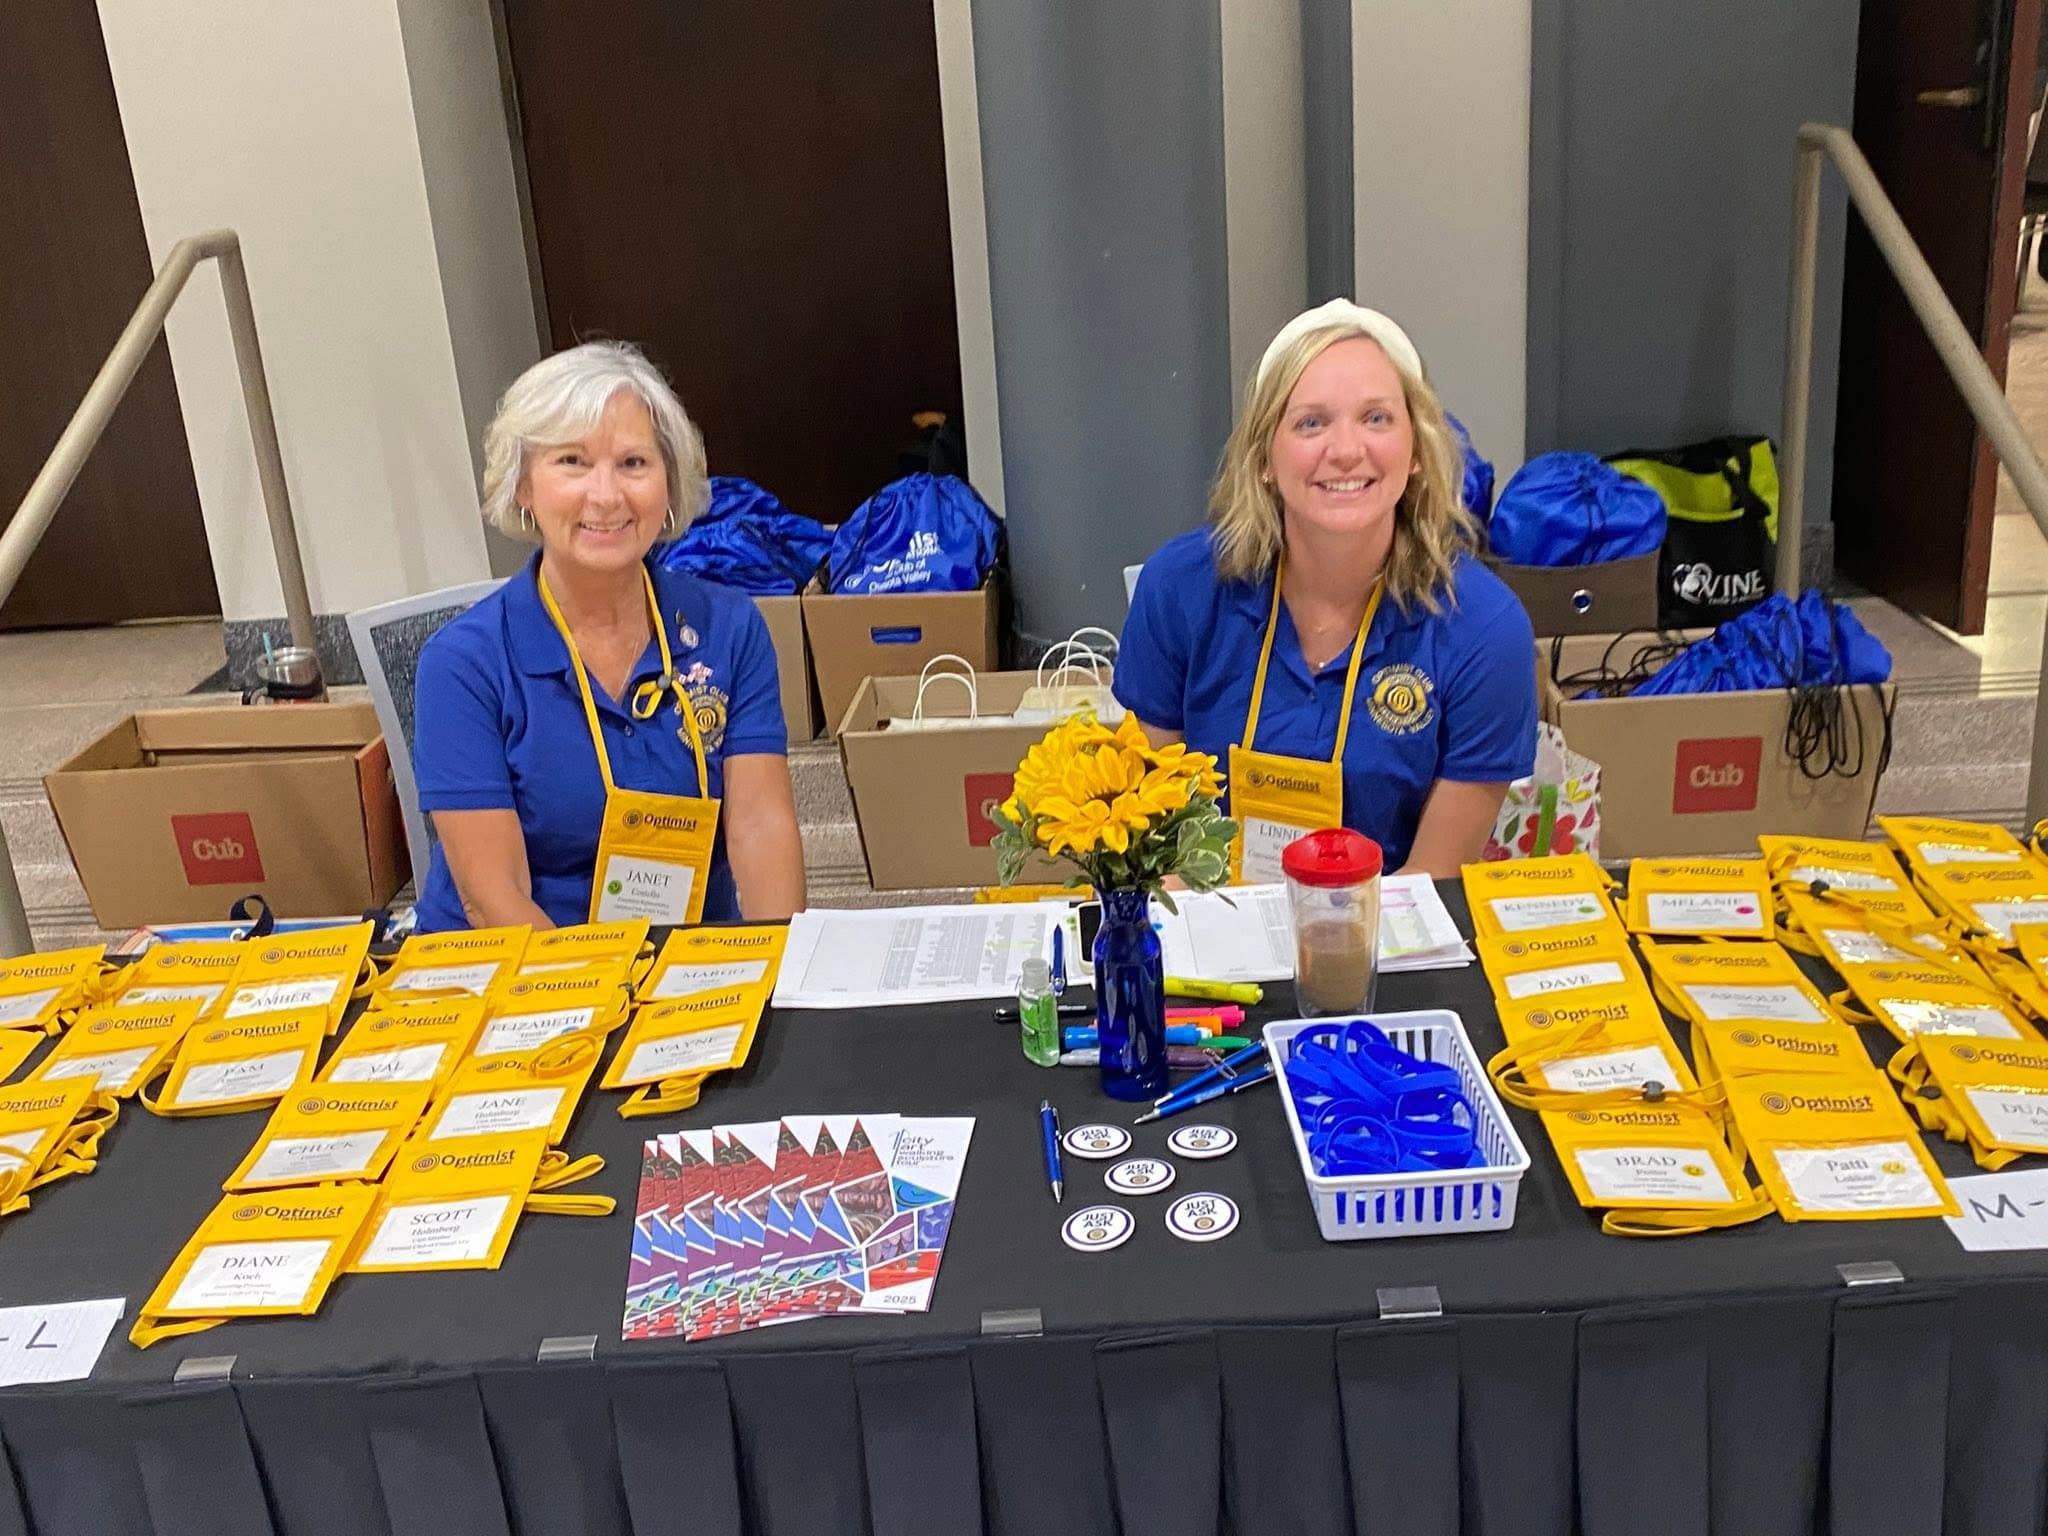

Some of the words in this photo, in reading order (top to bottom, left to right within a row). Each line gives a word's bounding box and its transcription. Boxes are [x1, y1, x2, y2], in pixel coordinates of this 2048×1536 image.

[1689, 763, 1744, 788] Cub
[1266, 774, 1321, 793] Optimist
[643, 812, 698, 830] Optimist
[1260, 824, 1302, 841] LINNE
[192, 837, 244, 860] Cub
[626, 870, 671, 886] JANET
[443, 938, 505, 950] Optimist
[1528, 935, 1597, 951] Optimist
[286, 944, 348, 960] Optimist
[182, 954, 241, 967] Optimist
[13, 963, 76, 978] Optimist
[534, 978, 600, 991] Optimist
[1539, 975, 1593, 990] DAVE
[677, 993, 742, 1011] Optimist
[113, 1014, 176, 1030] Optimist
[393, 1013, 460, 1027] Optimist
[491, 1015, 586, 1031] ELIZABETH
[231, 1021, 300, 1037] Optimist
[1761, 1033, 1839, 1054] Optimist
[1980, 1049, 2048, 1069] Optimis
[223, 1063, 266, 1076] PAM
[369, 1062, 404, 1074] VAL
[1572, 1063, 1636, 1077] SALLY
[326, 1099, 399, 1112] Optimist
[478, 1097, 527, 1110] JANE
[1790, 1095, 1873, 1111] Optimist
[1598, 1111, 1680, 1124] Optimist
[287, 1140, 354, 1154] CHUCK
[441, 1150, 515, 1167] Optimist
[1615, 1156, 1677, 1166] BRAD
[1825, 1158, 1869, 1171] Patti
[1185, 1199, 1216, 1211] JUST
[1188, 1207, 1217, 1217] ASK
[264, 1206, 344, 1220] Optimist
[410, 1208, 477, 1225] SCOTT
[1083, 1212, 1116, 1221] JUST
[1083, 1219, 1112, 1229] ASK
[222, 1255, 291, 1269] DIANE
[883, 1294, 917, 1305] 2025
